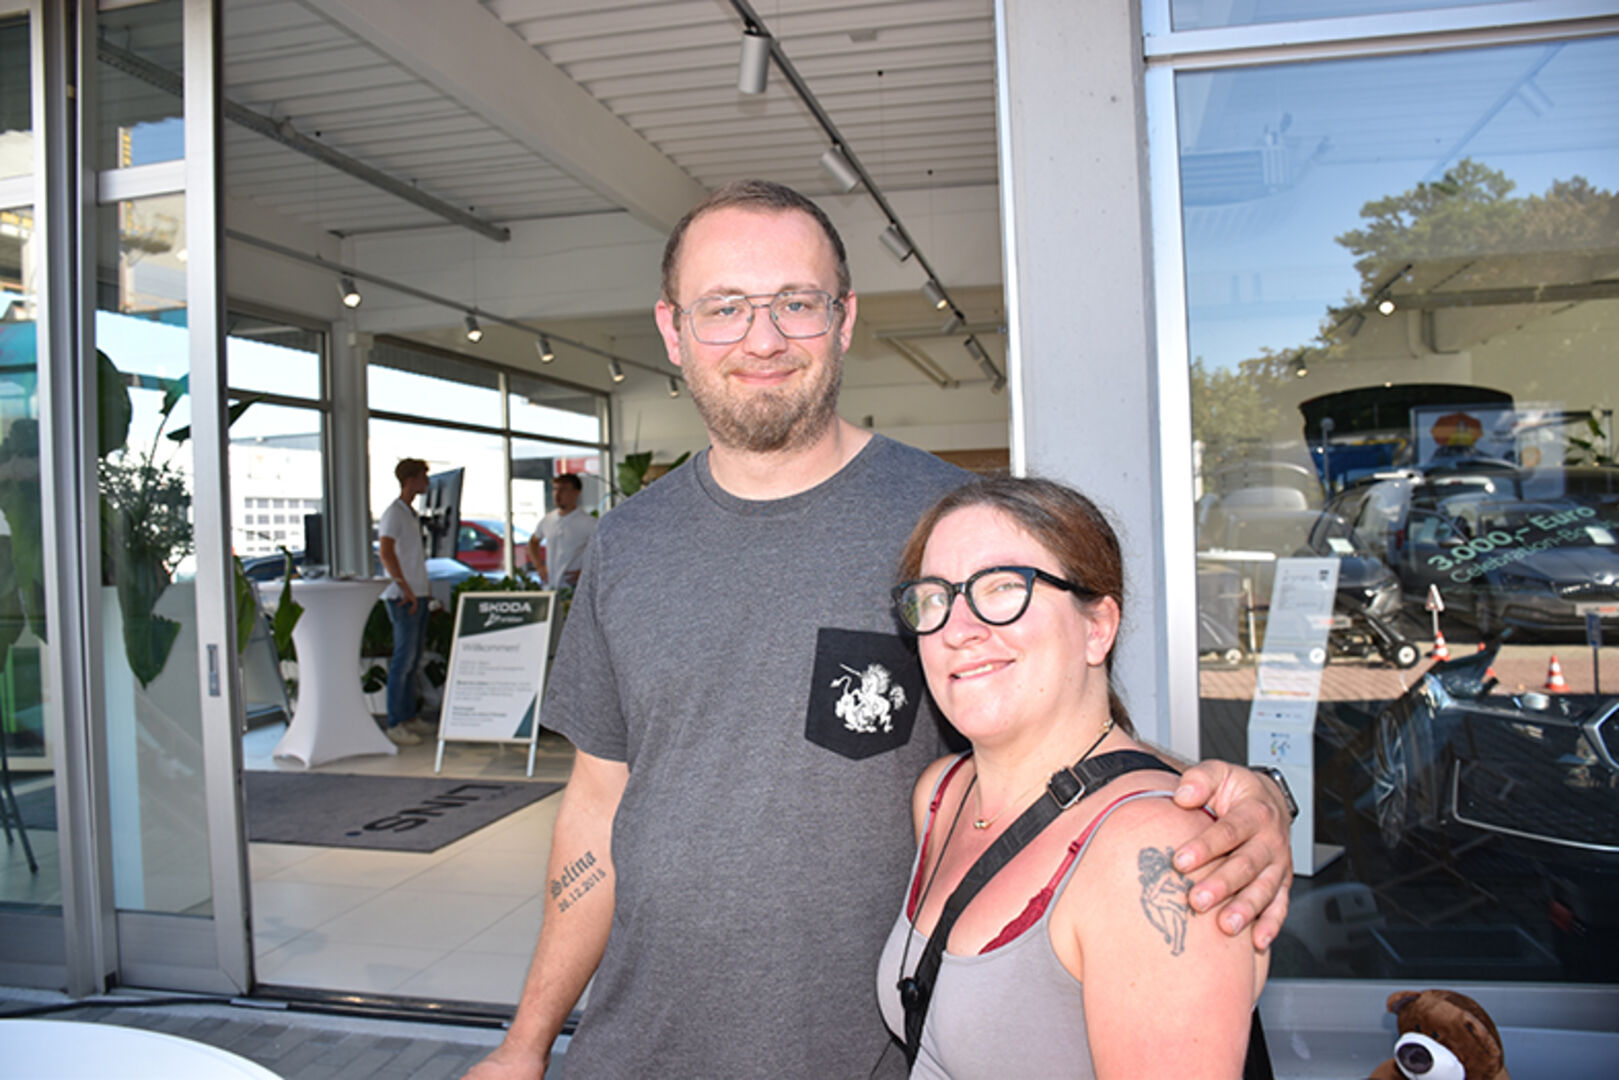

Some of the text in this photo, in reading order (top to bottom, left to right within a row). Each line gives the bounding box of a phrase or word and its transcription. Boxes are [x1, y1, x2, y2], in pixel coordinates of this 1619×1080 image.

[1428, 506, 1596, 571] 3.000,- Euro
[1451, 519, 1619, 583] Celebration-Bo
[551, 850, 597, 901] Selina
